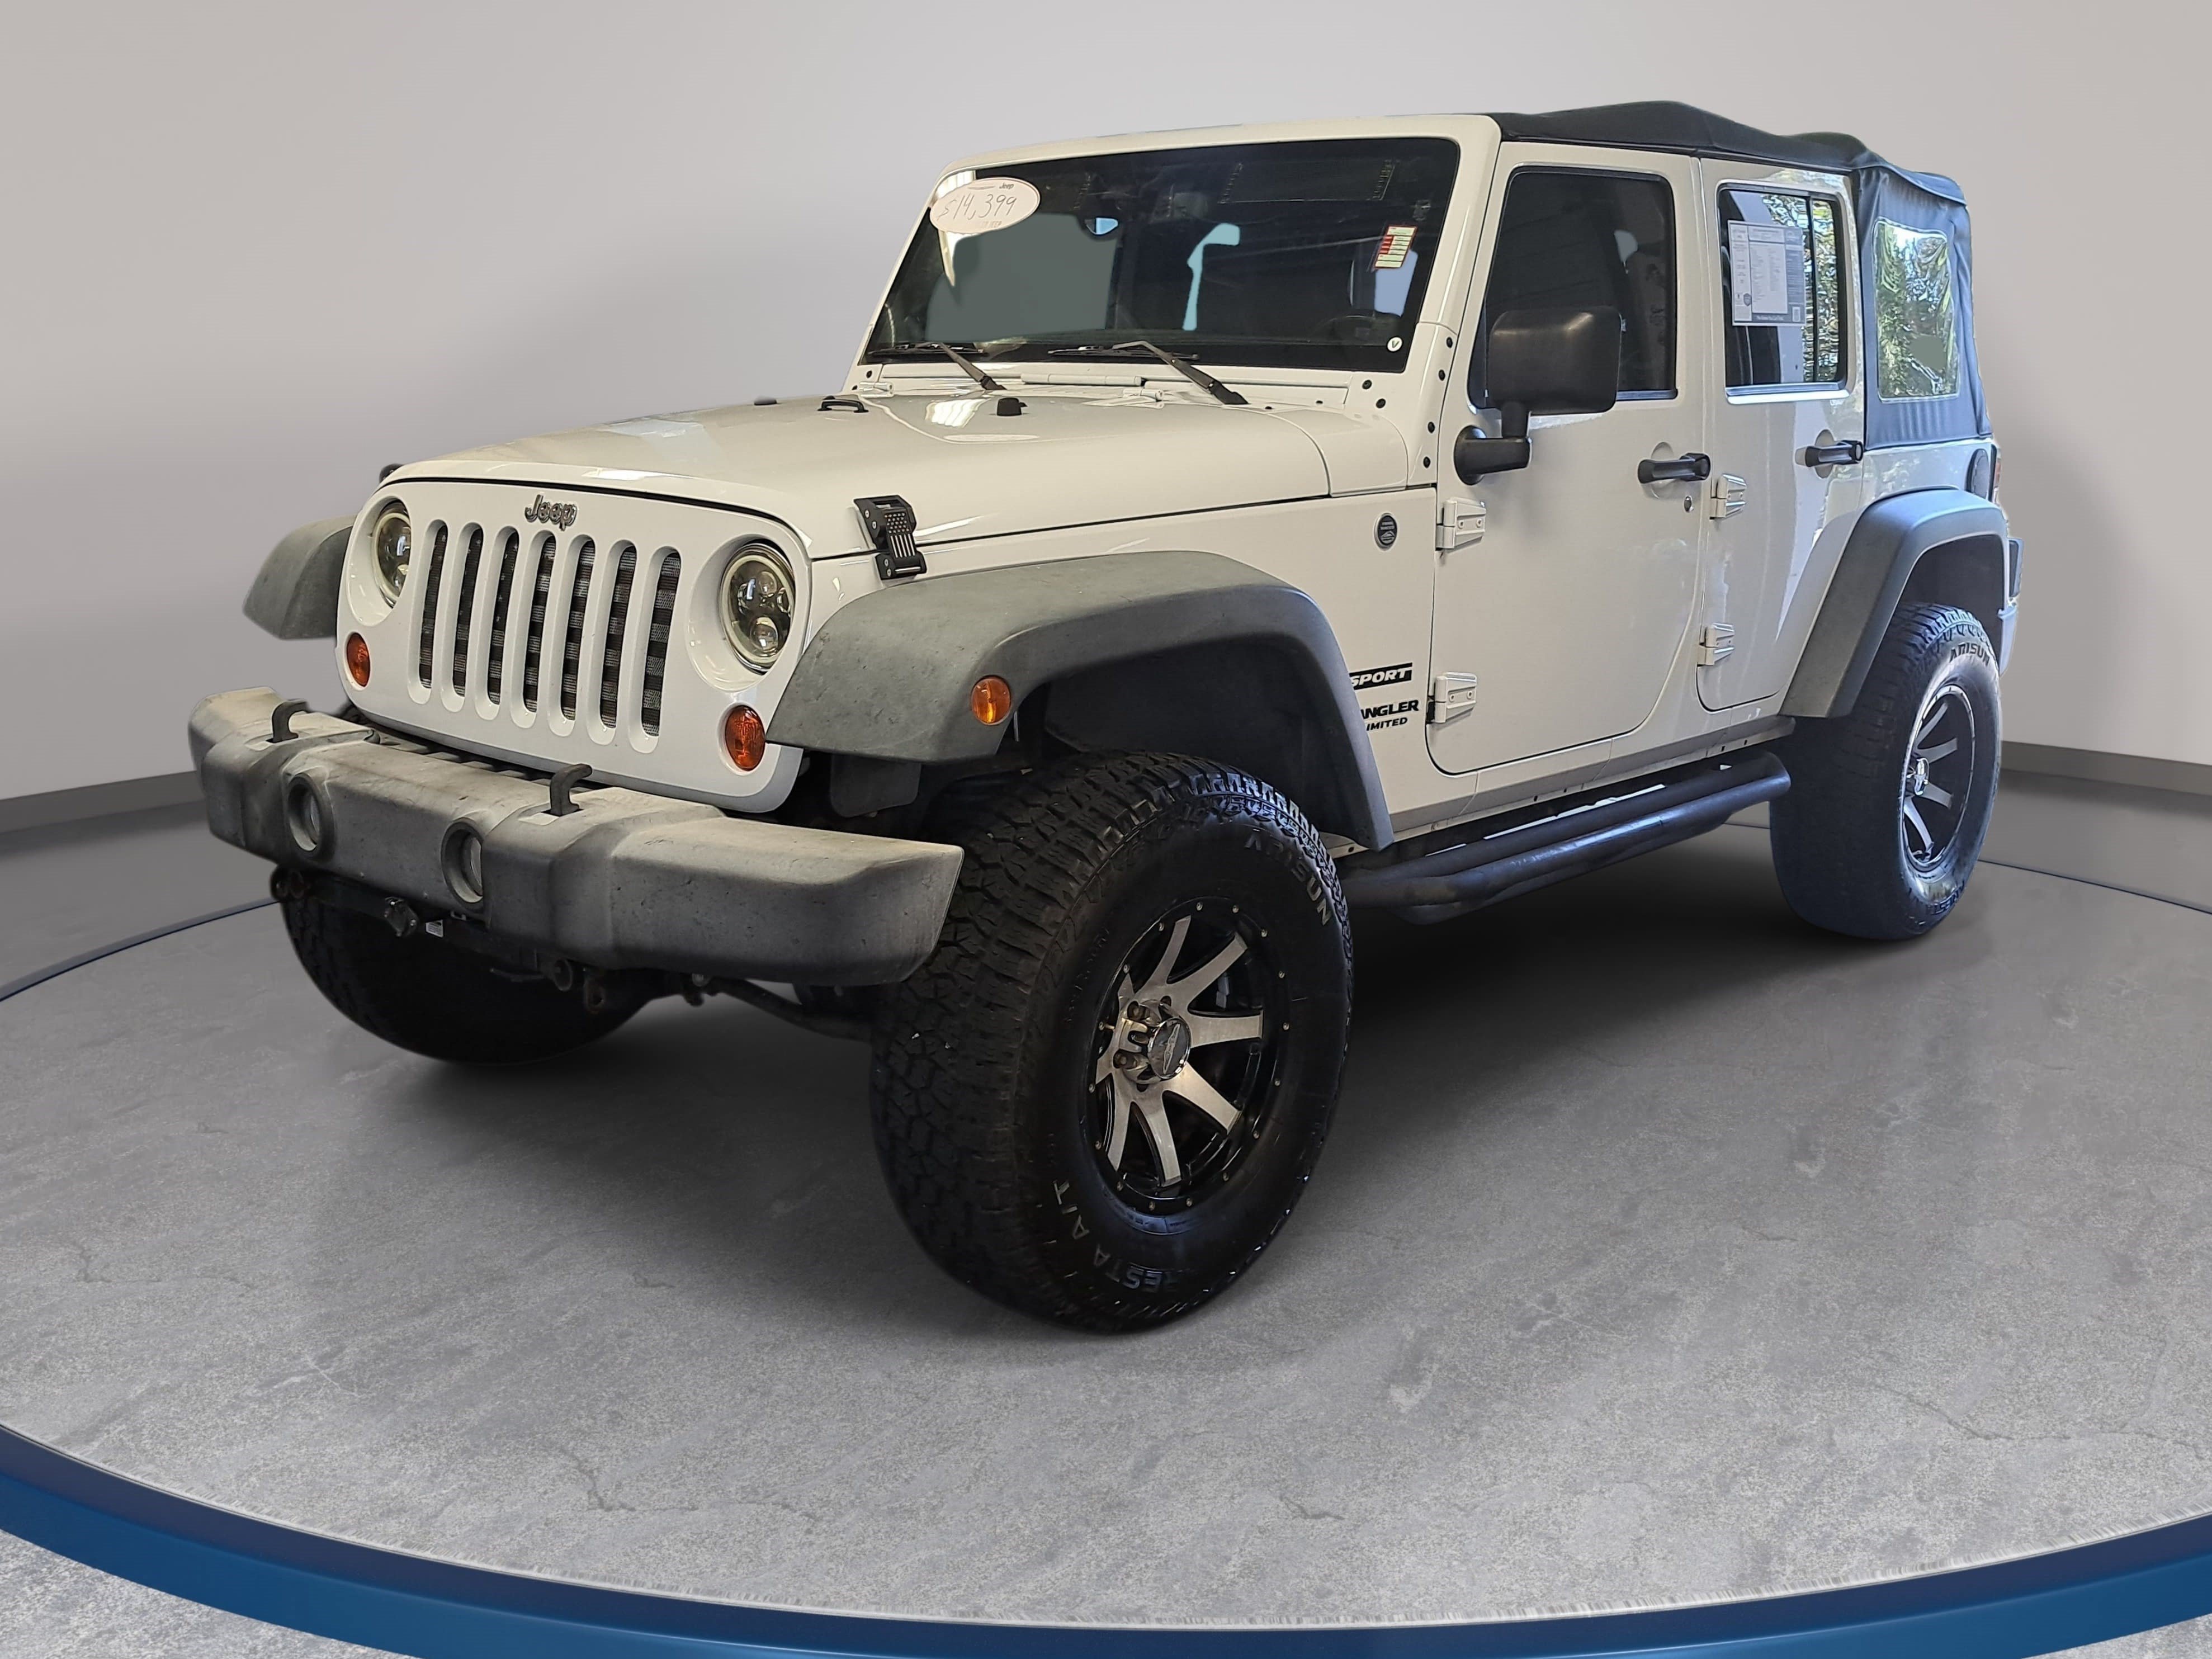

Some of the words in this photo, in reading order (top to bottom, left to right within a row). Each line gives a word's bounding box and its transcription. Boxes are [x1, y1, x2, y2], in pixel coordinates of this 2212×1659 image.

[524, 494, 577, 531] Jeep
[1350, 667, 1412, 687] SPORT
[1366, 717, 1408, 731] IMITED
